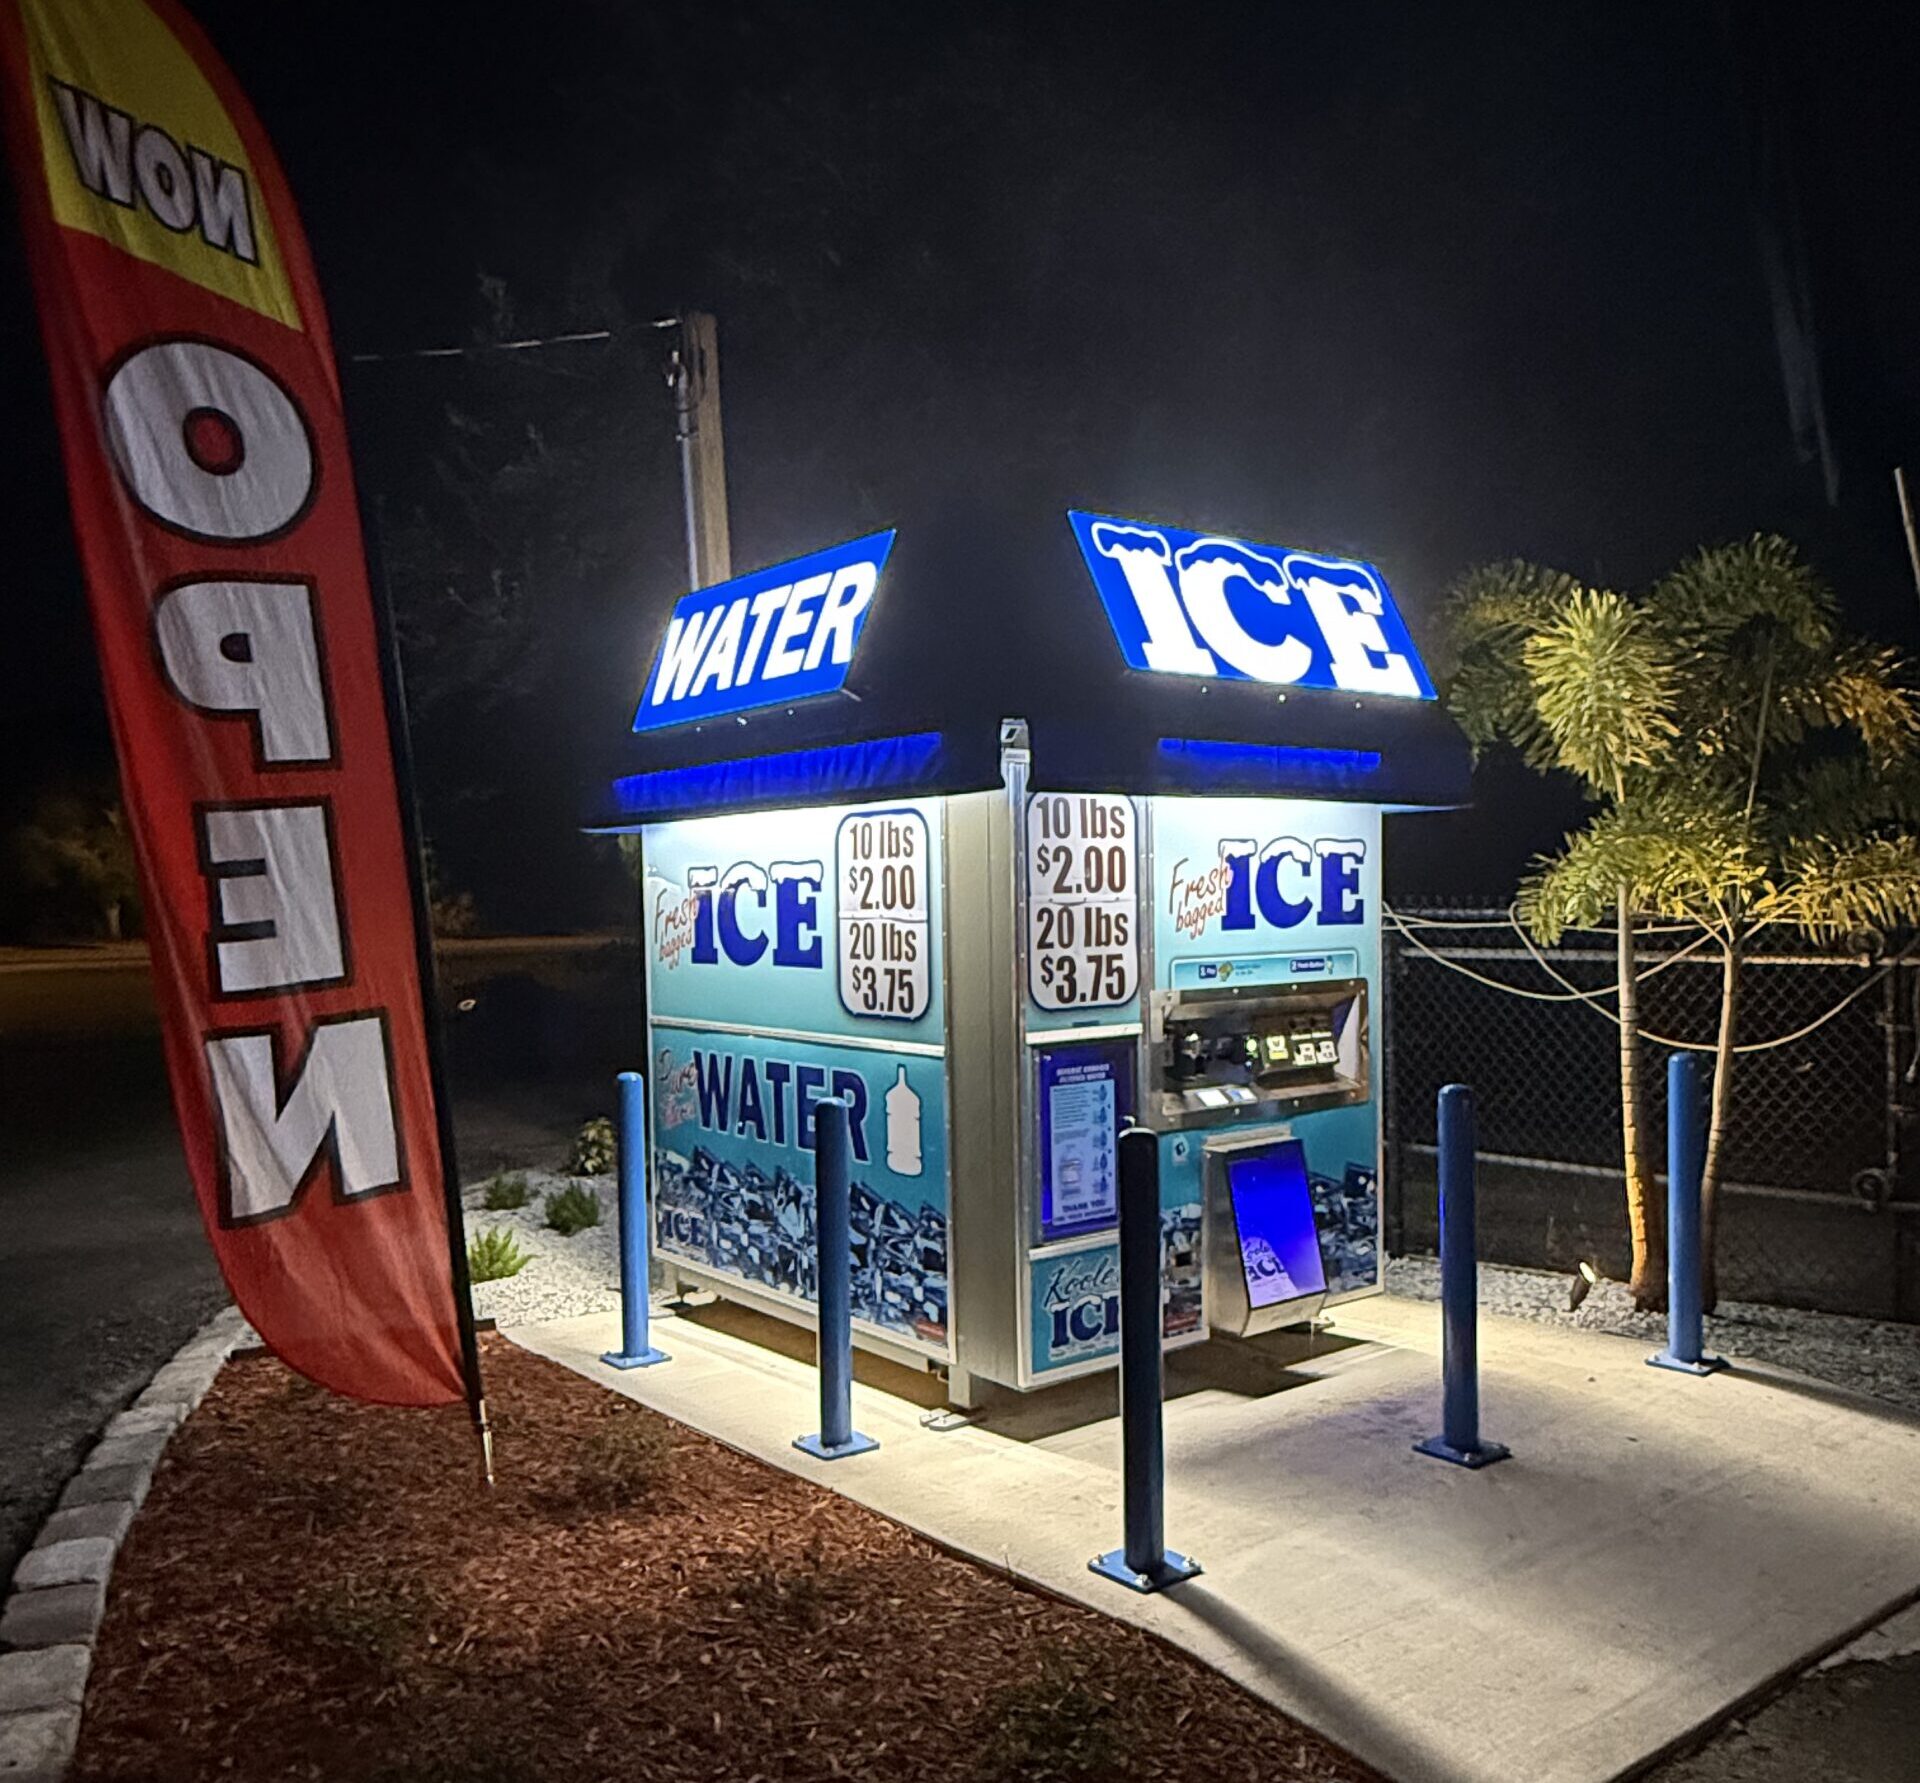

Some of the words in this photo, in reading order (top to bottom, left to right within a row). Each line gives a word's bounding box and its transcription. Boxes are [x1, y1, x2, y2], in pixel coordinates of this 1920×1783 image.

[651, 561, 877, 706] WATER
[1091, 522, 1421, 698] ICE
[850, 823, 872, 860] 10
[879, 820, 914, 859] lbs
[1036, 797, 1071, 839] 10
[1080, 798, 1126, 839] lbs
[849, 864, 916, 911] $2.00
[1036, 844, 1127, 894] $2.00
[1169, 845, 1233, 915] Fresh
[1218, 836, 1367, 931] ICE
[687, 859, 825, 970] ICE
[1036, 907, 1075, 950] 20
[1084, 907, 1129, 947] lbs
[1175, 888, 1224, 940] bagged
[849, 923, 875, 961] 20
[882, 923, 917, 963] lbs
[852, 964, 914, 1014] $3.75
[1040, 954, 1126, 1004] $3.75
[693, 1050, 869, 1163] WATER
[1043, 1257, 1120, 1308] Koole
